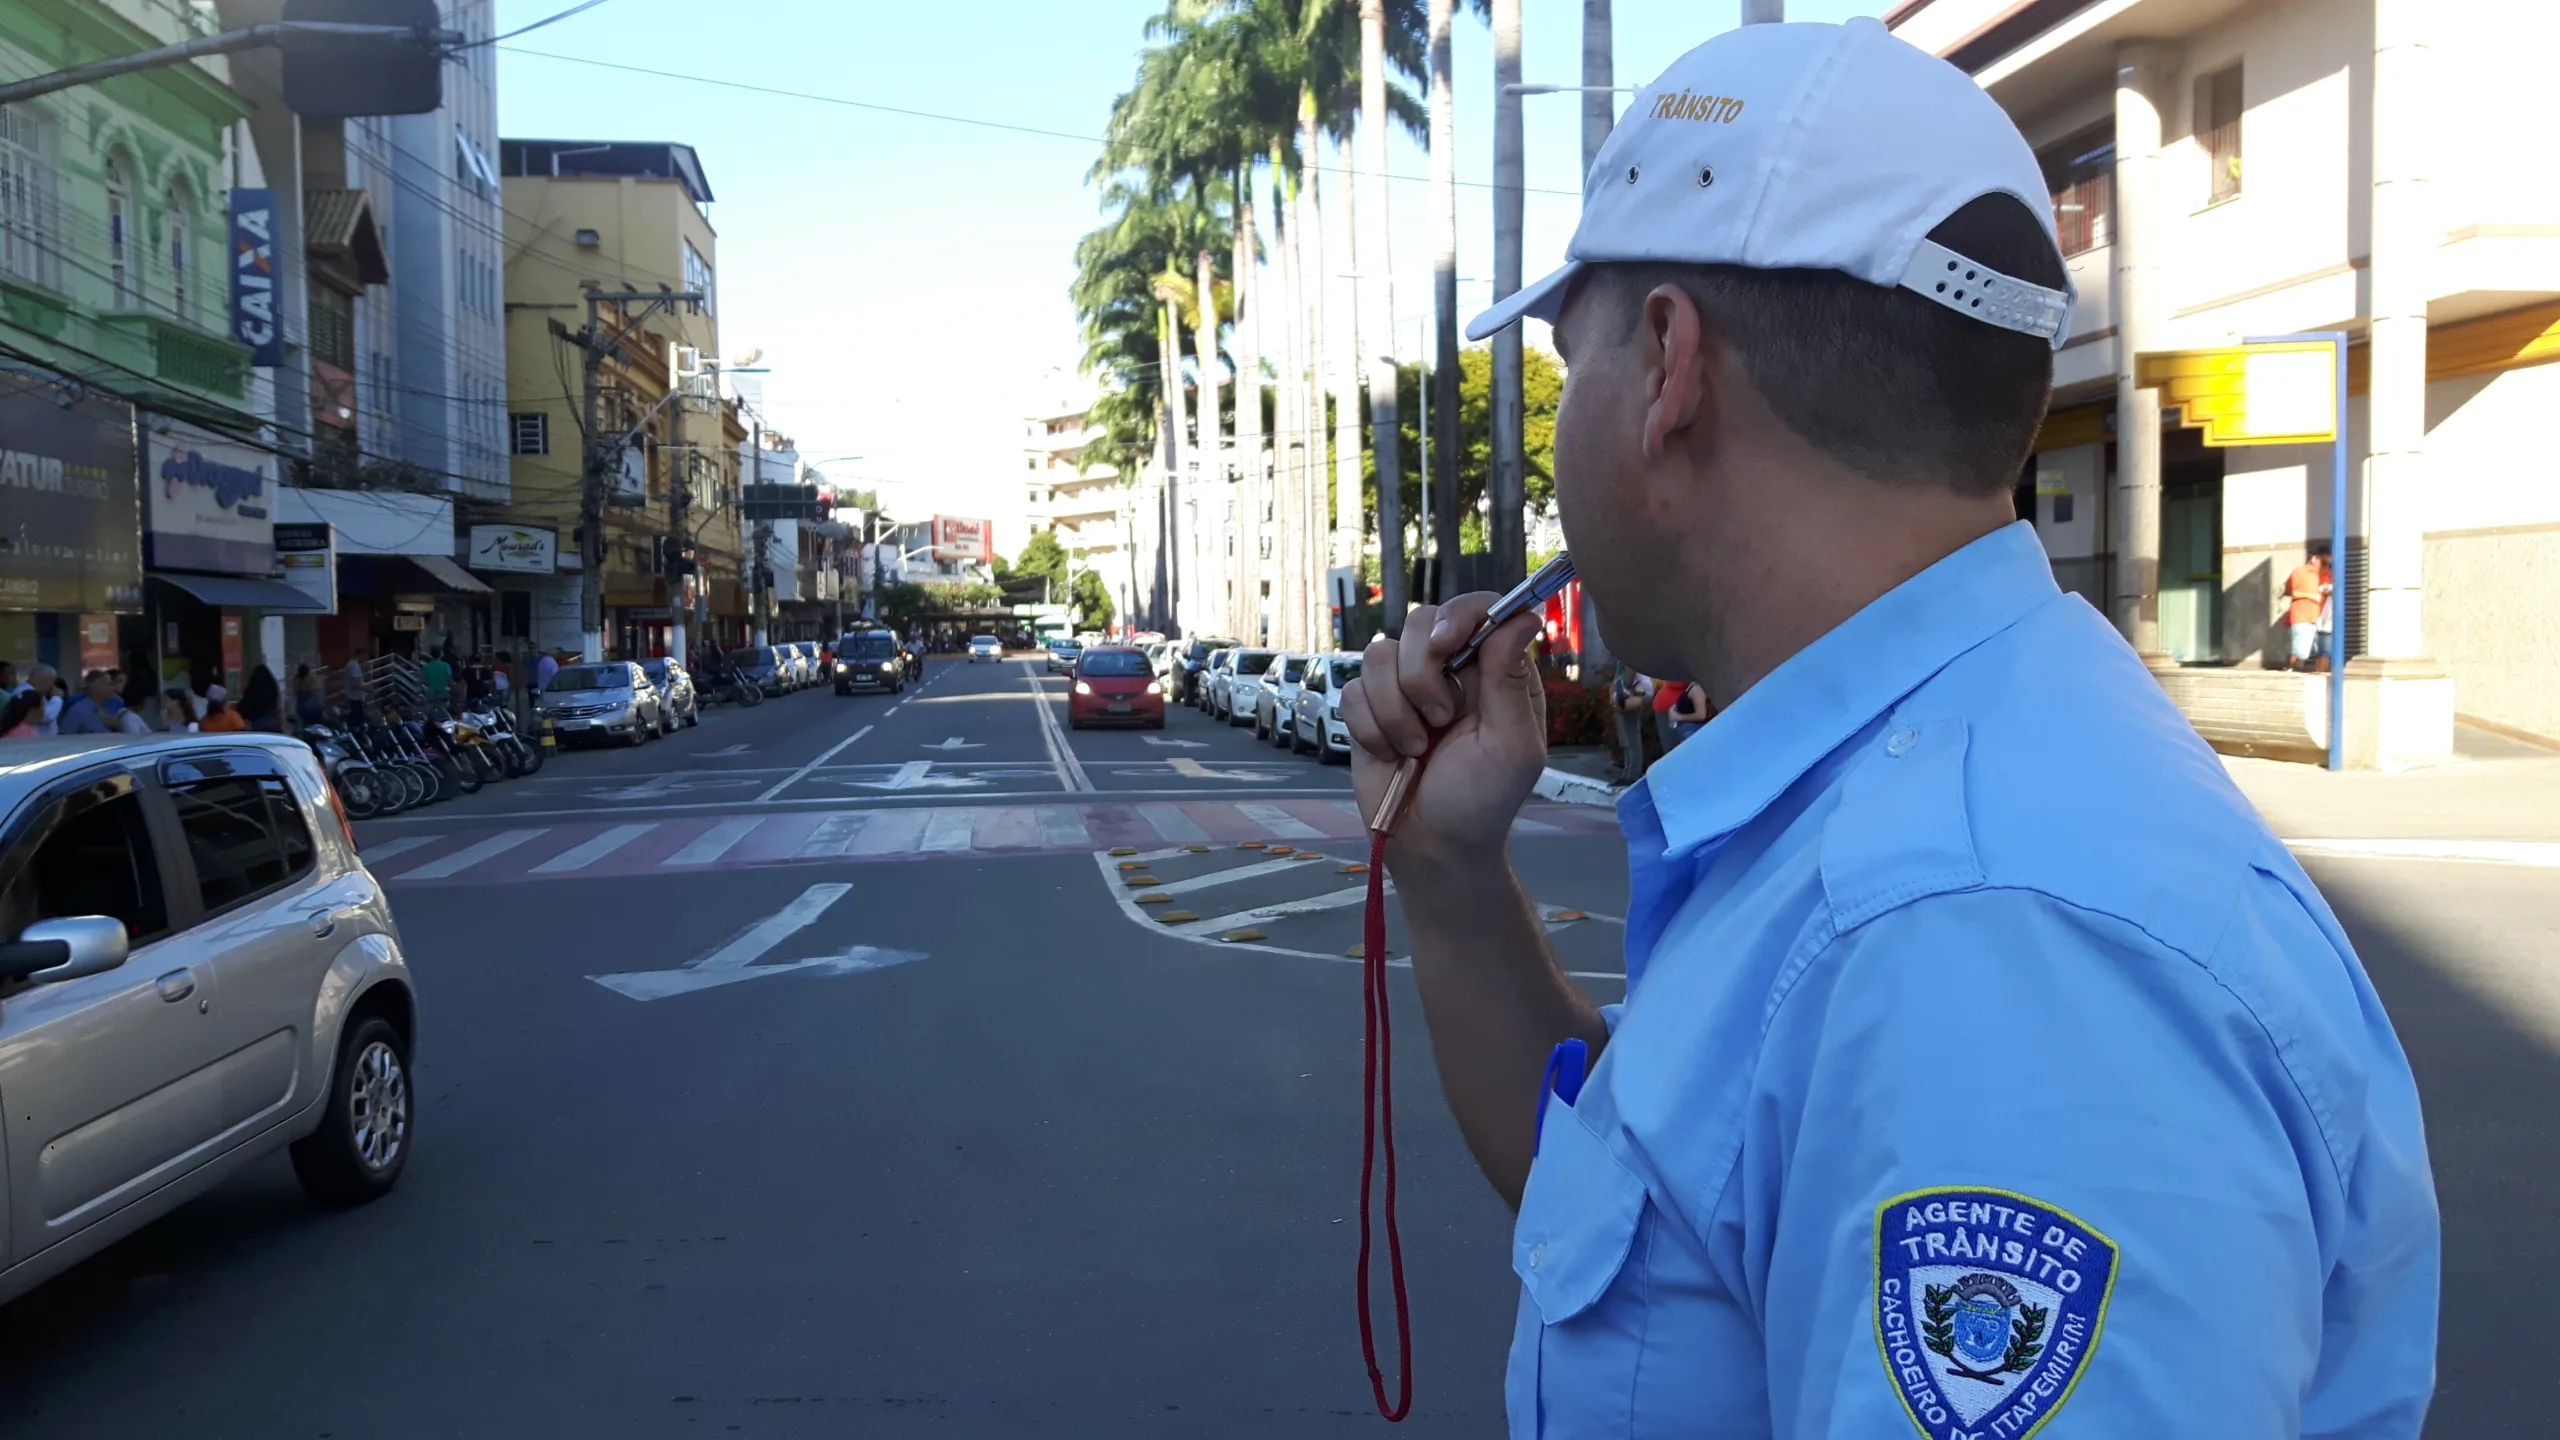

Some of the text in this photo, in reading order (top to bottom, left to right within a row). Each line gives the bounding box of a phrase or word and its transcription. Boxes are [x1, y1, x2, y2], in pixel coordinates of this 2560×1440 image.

[1648, 87, 1744, 124] TRÂNSITO
[237, 208, 275, 346] CAIXA
[0, 449, 63, 492] ATUR
[1899, 1226, 2082, 1293] TRÂNSITO
[1905, 1201, 2088, 1262] AGENTE DE
[1883, 1278, 1947, 1424] CACHOEIRO
[1990, 1312, 2086, 1439] ITAPEMIRIM
